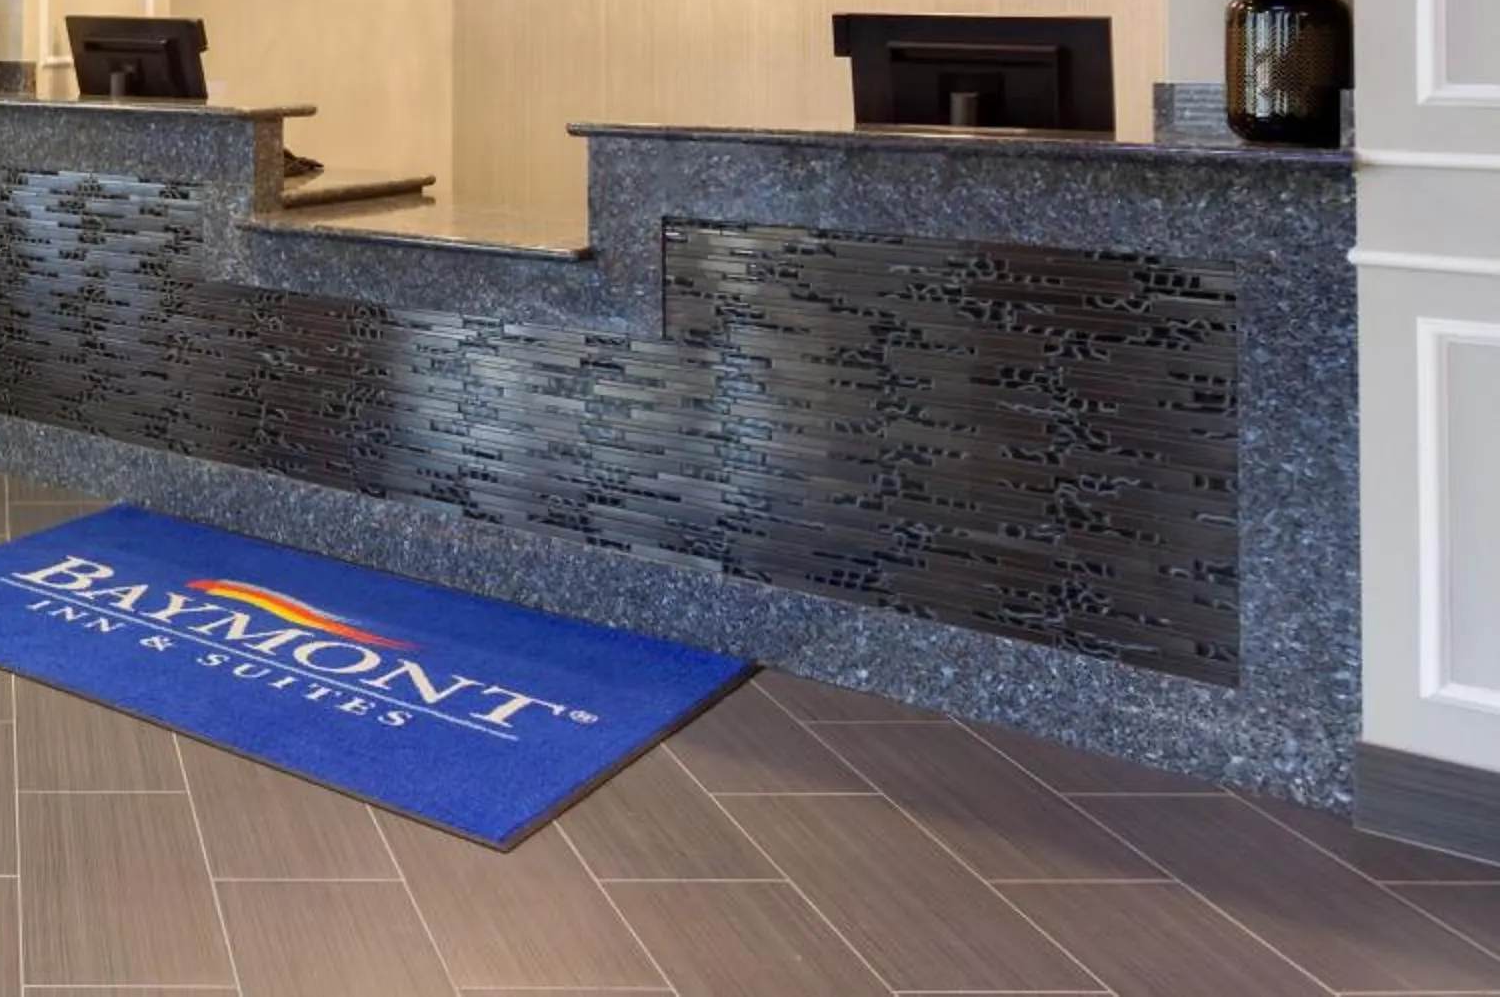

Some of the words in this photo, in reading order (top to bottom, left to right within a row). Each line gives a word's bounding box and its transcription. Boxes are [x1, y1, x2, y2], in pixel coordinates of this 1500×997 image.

[26, 600, 127, 633] INN
[140, 635, 175, 651] &
[197, 654, 412, 727] SUITES
